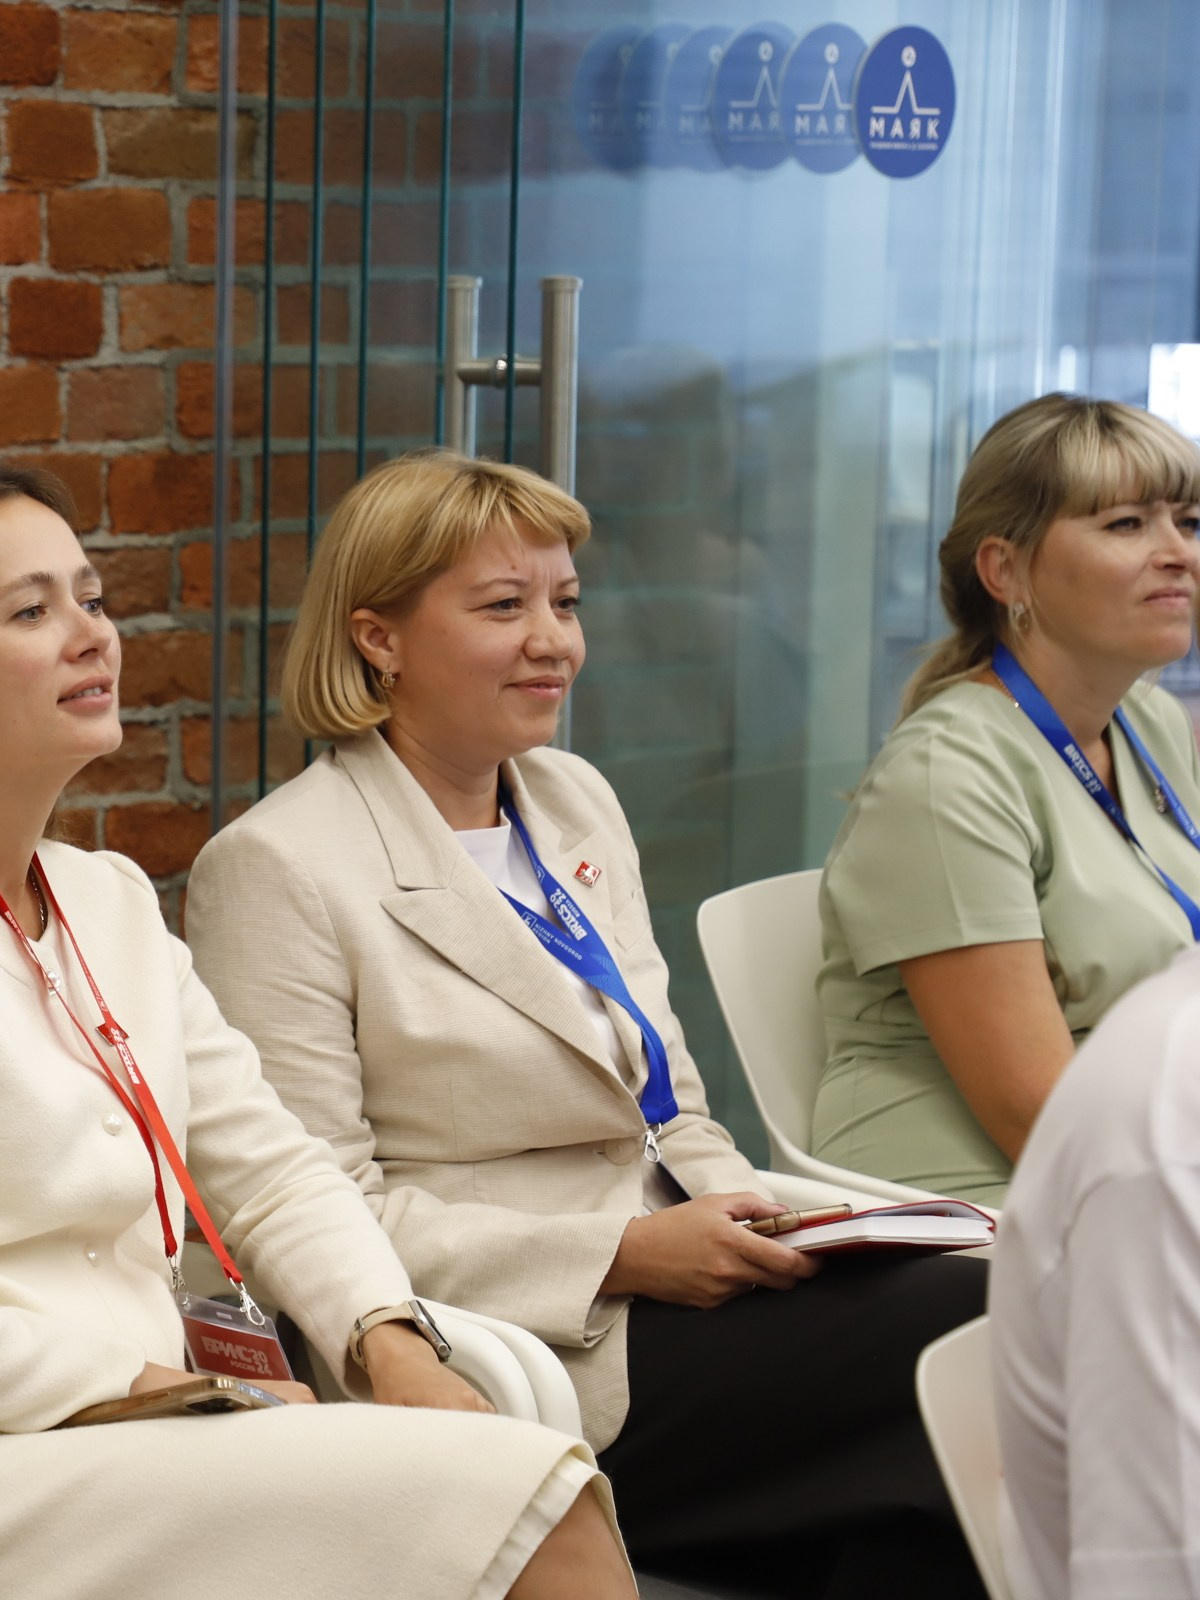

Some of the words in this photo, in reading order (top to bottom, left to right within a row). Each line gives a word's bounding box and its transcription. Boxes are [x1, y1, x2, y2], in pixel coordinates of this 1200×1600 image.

[795, 113, 846, 135] МАЯ
[869, 116, 940, 139] МАЯК
[1064, 743, 1093, 780] BRICS
[550, 894, 562, 909] 20
[554, 888, 567, 902] 24
[565, 898, 580, 918] RUSSIA
[557, 903, 587, 941] BRICS
[535, 923, 555, 939] NIZHNY
[554, 937, 582, 960] NOVGOROD
[117, 1042, 140, 1084] BRICS
[248, 1348, 268, 1364] 20
[254, 1361, 273, 1376] 24
